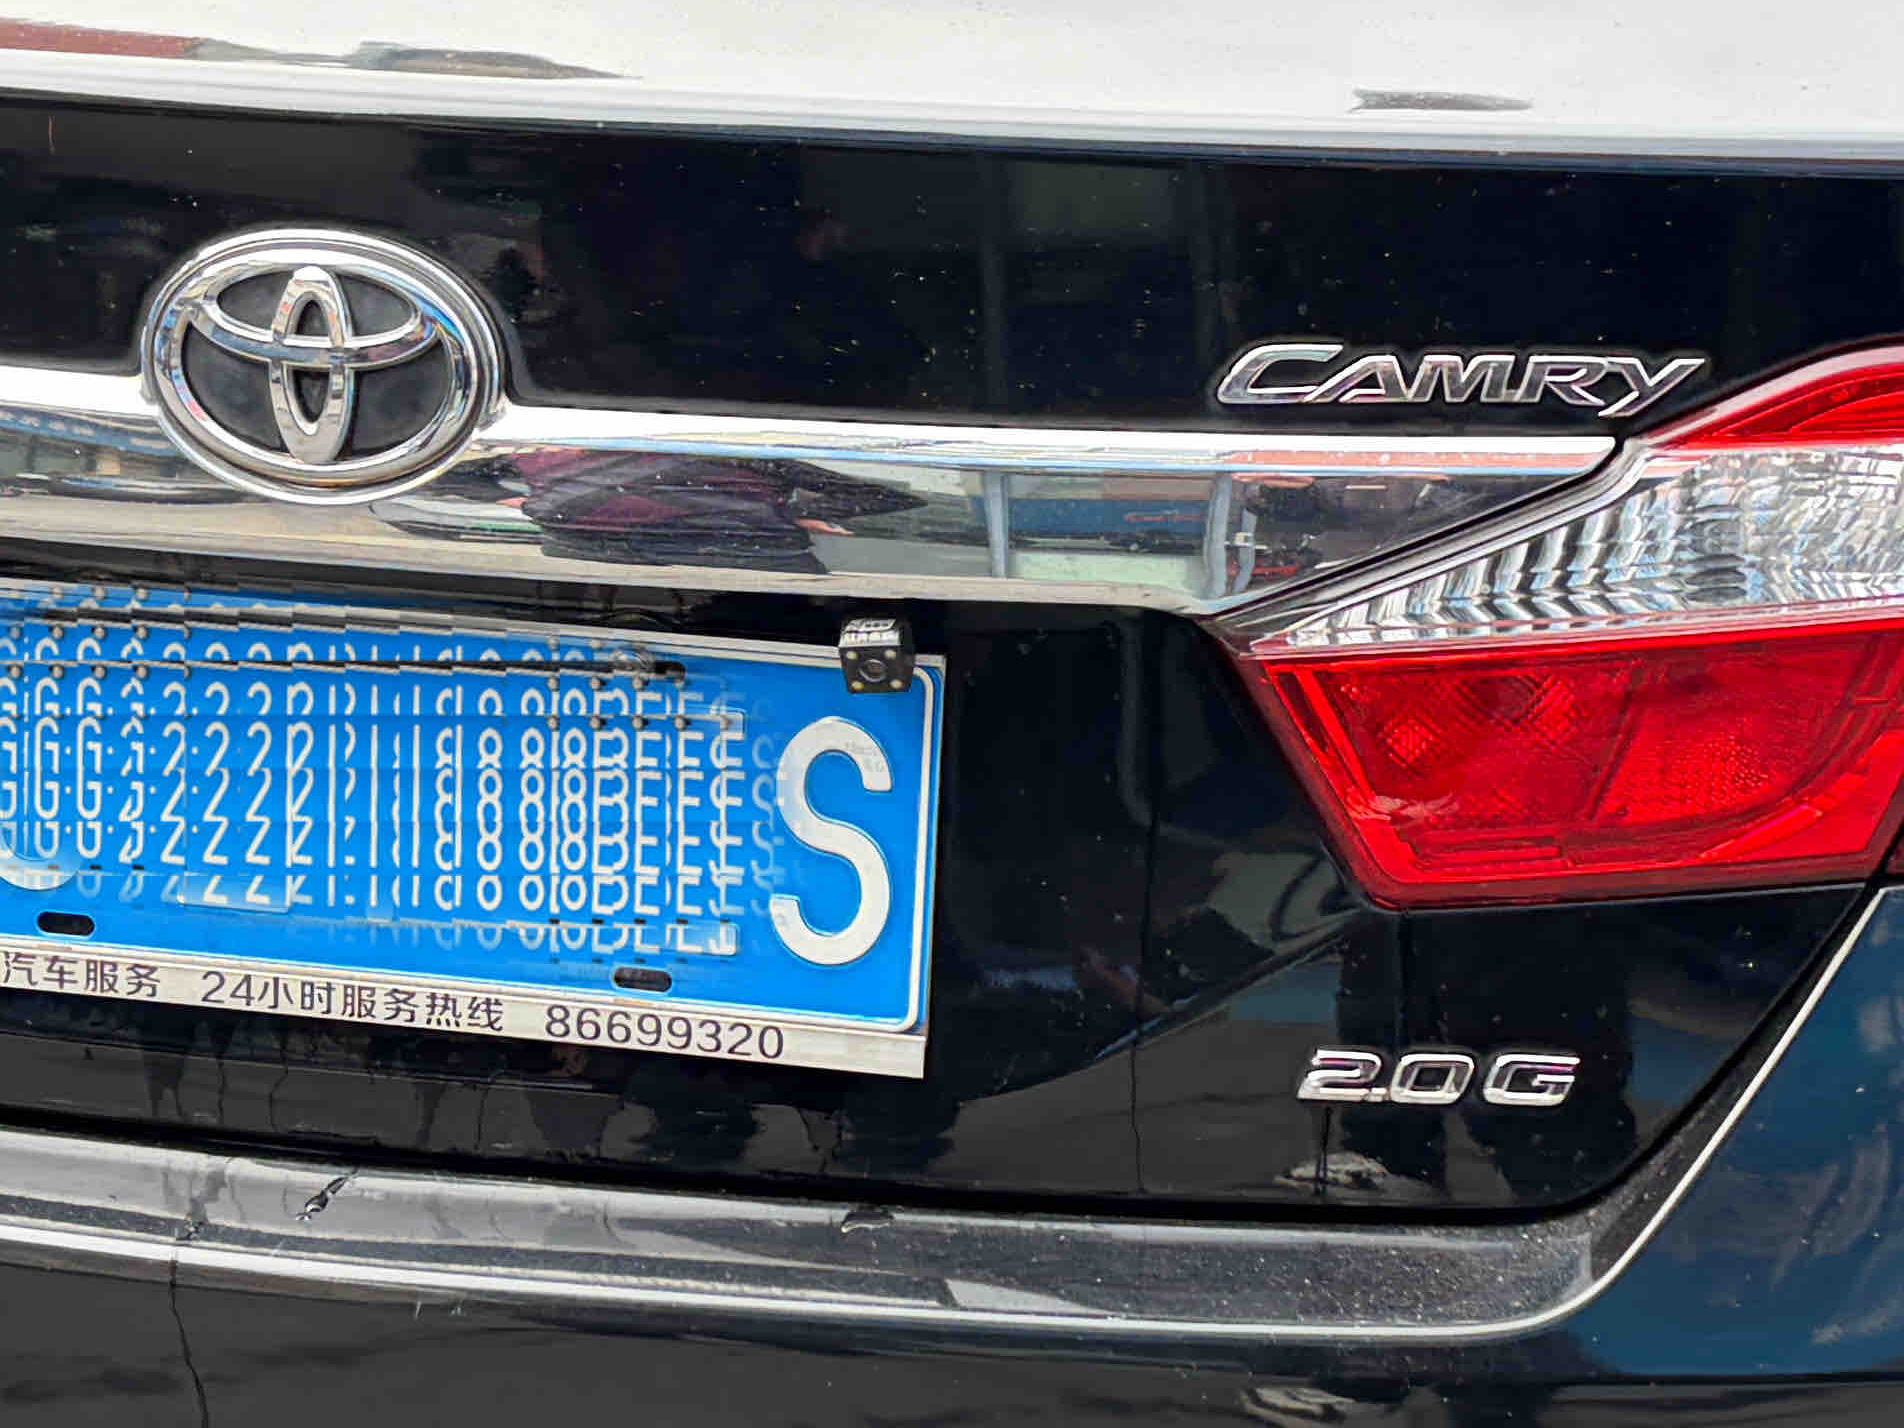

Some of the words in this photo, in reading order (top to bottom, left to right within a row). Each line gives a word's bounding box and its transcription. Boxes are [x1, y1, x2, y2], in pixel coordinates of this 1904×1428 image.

[1217, 342, 1706, 419] CAMRY
[200, 970, 505, 1032] 24小时服务热线
[545, 1004, 785, 1060] 86699320
[1297, 1048, 1582, 1106] 2.0G
